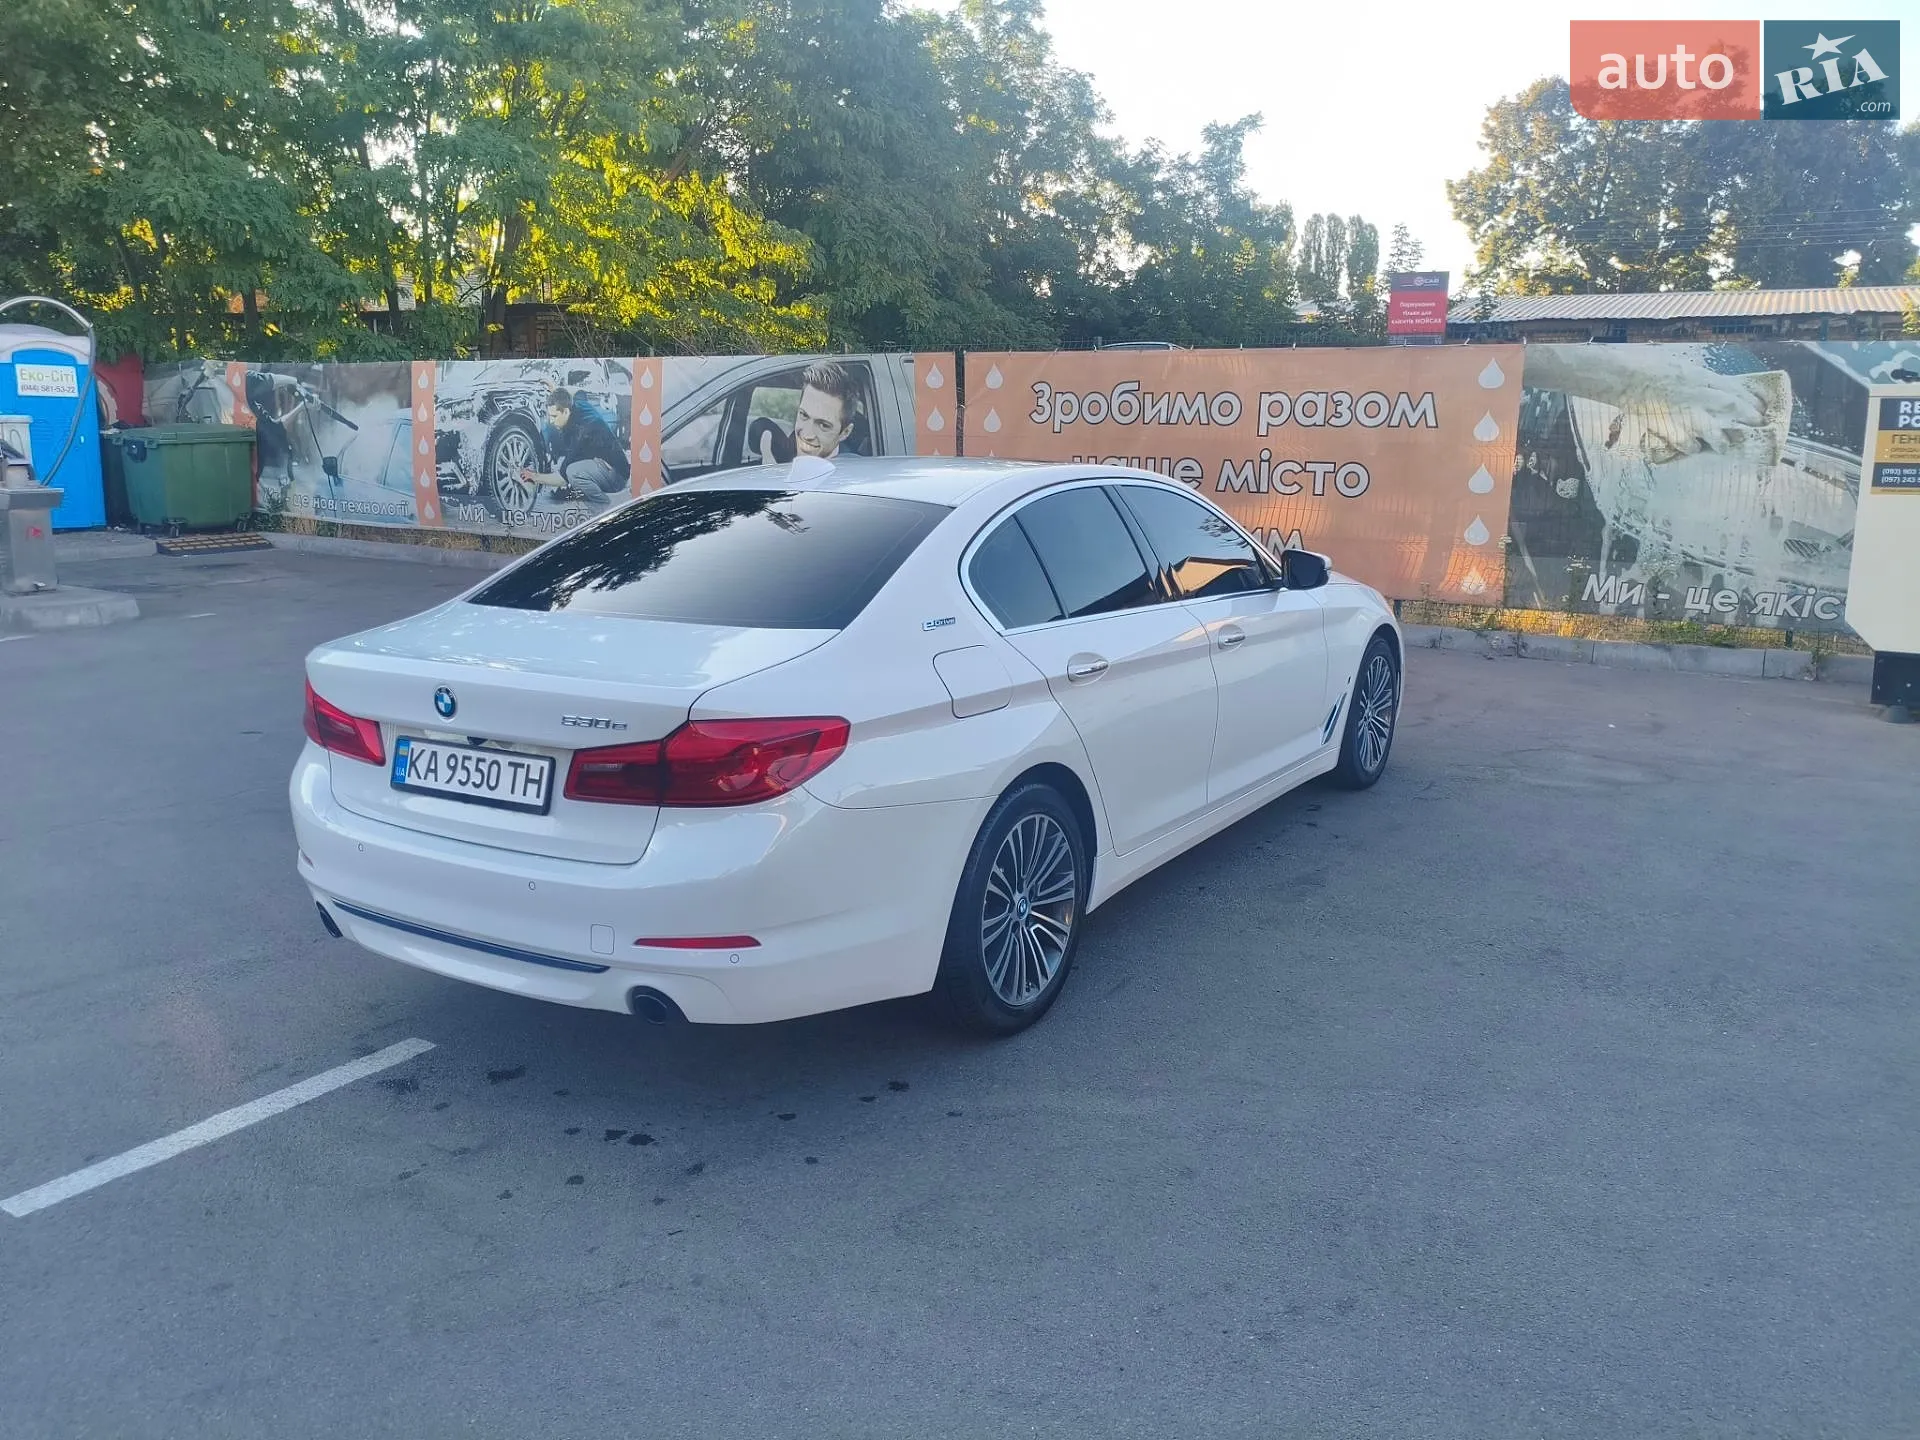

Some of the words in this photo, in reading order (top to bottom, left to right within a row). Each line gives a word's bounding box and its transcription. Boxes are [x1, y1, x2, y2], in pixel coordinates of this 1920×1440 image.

[20, 368, 75, 384] Еко-Сіті
[1029, 380, 1243, 434] Зробимо
[1256, 390, 1438, 437] разом
[1892, 434, 1920, 444] ГЕН
[1215, 448, 1370, 498] місто
[293, 494, 309, 508] це
[312, 495, 338, 512] нові
[341, 500, 410, 516] технології
[458, 503, 485, 522] Ми
[501, 509, 526, 527] це
[1581, 573, 1645, 606] Ми
[1684, 586, 1740, 615] це
[1751, 586, 1848, 622] якіс
[407, 747, 439, 783] KA
[444, 752, 502, 792] 9550
[507, 760, 545, 800] TH
